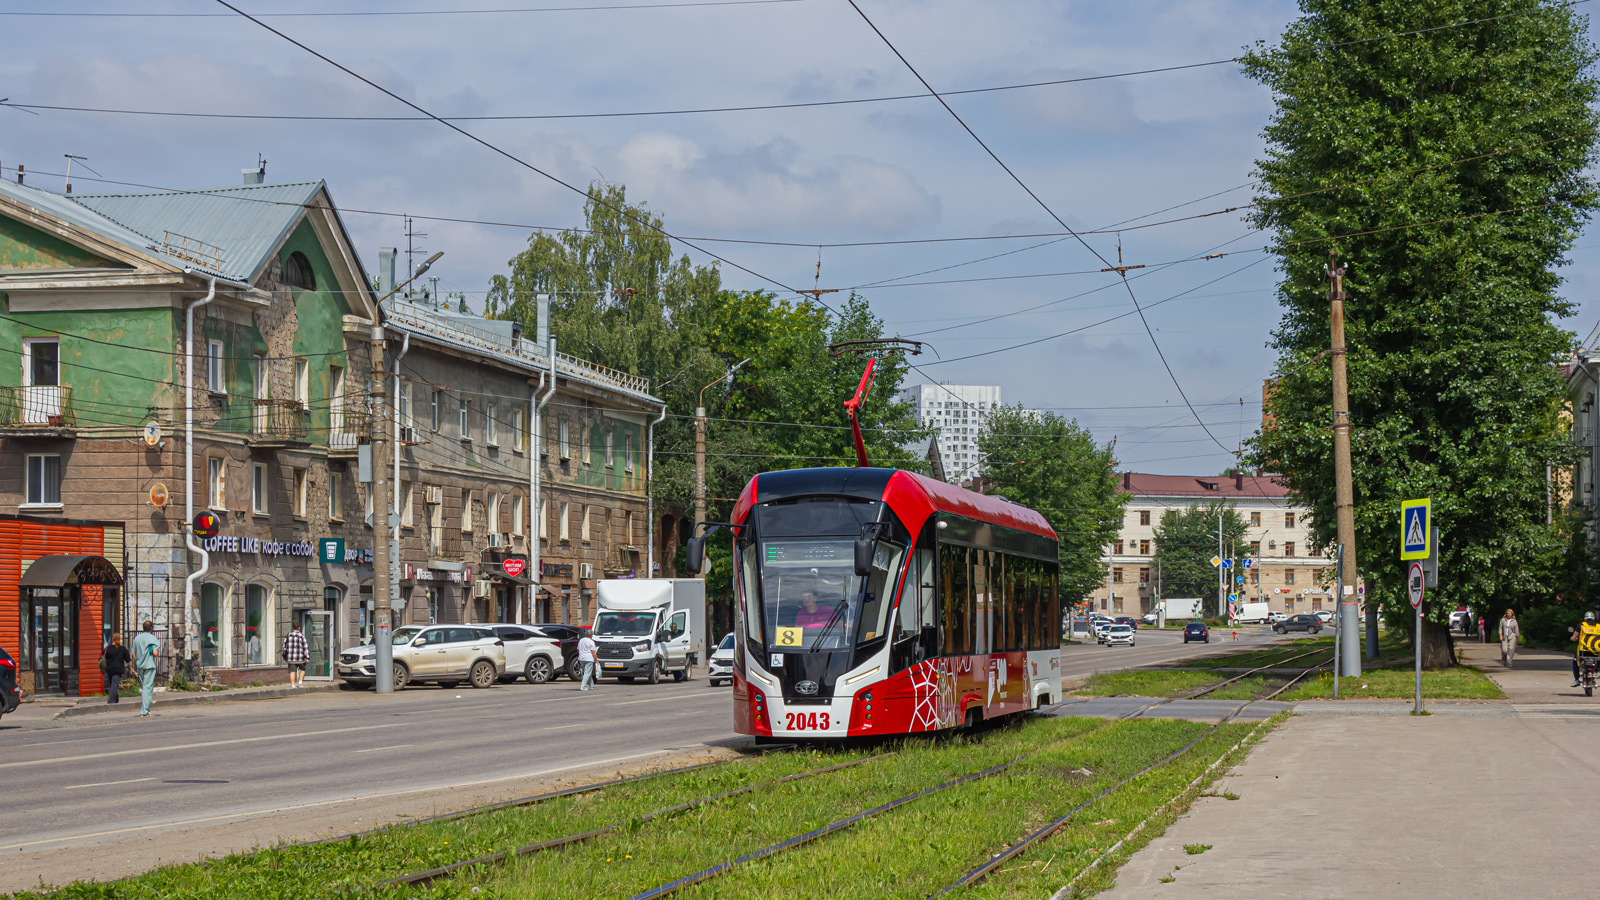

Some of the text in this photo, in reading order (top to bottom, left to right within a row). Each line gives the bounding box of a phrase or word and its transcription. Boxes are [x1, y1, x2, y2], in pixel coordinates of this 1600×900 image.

[204, 536, 238, 552] COFFEE
[241, 537, 258, 554] LIKE
[262, 538, 284, 558] кофе
[292, 540, 314, 556] собой
[781, 630, 795, 645] 8
[785, 712, 830, 731] 2043
